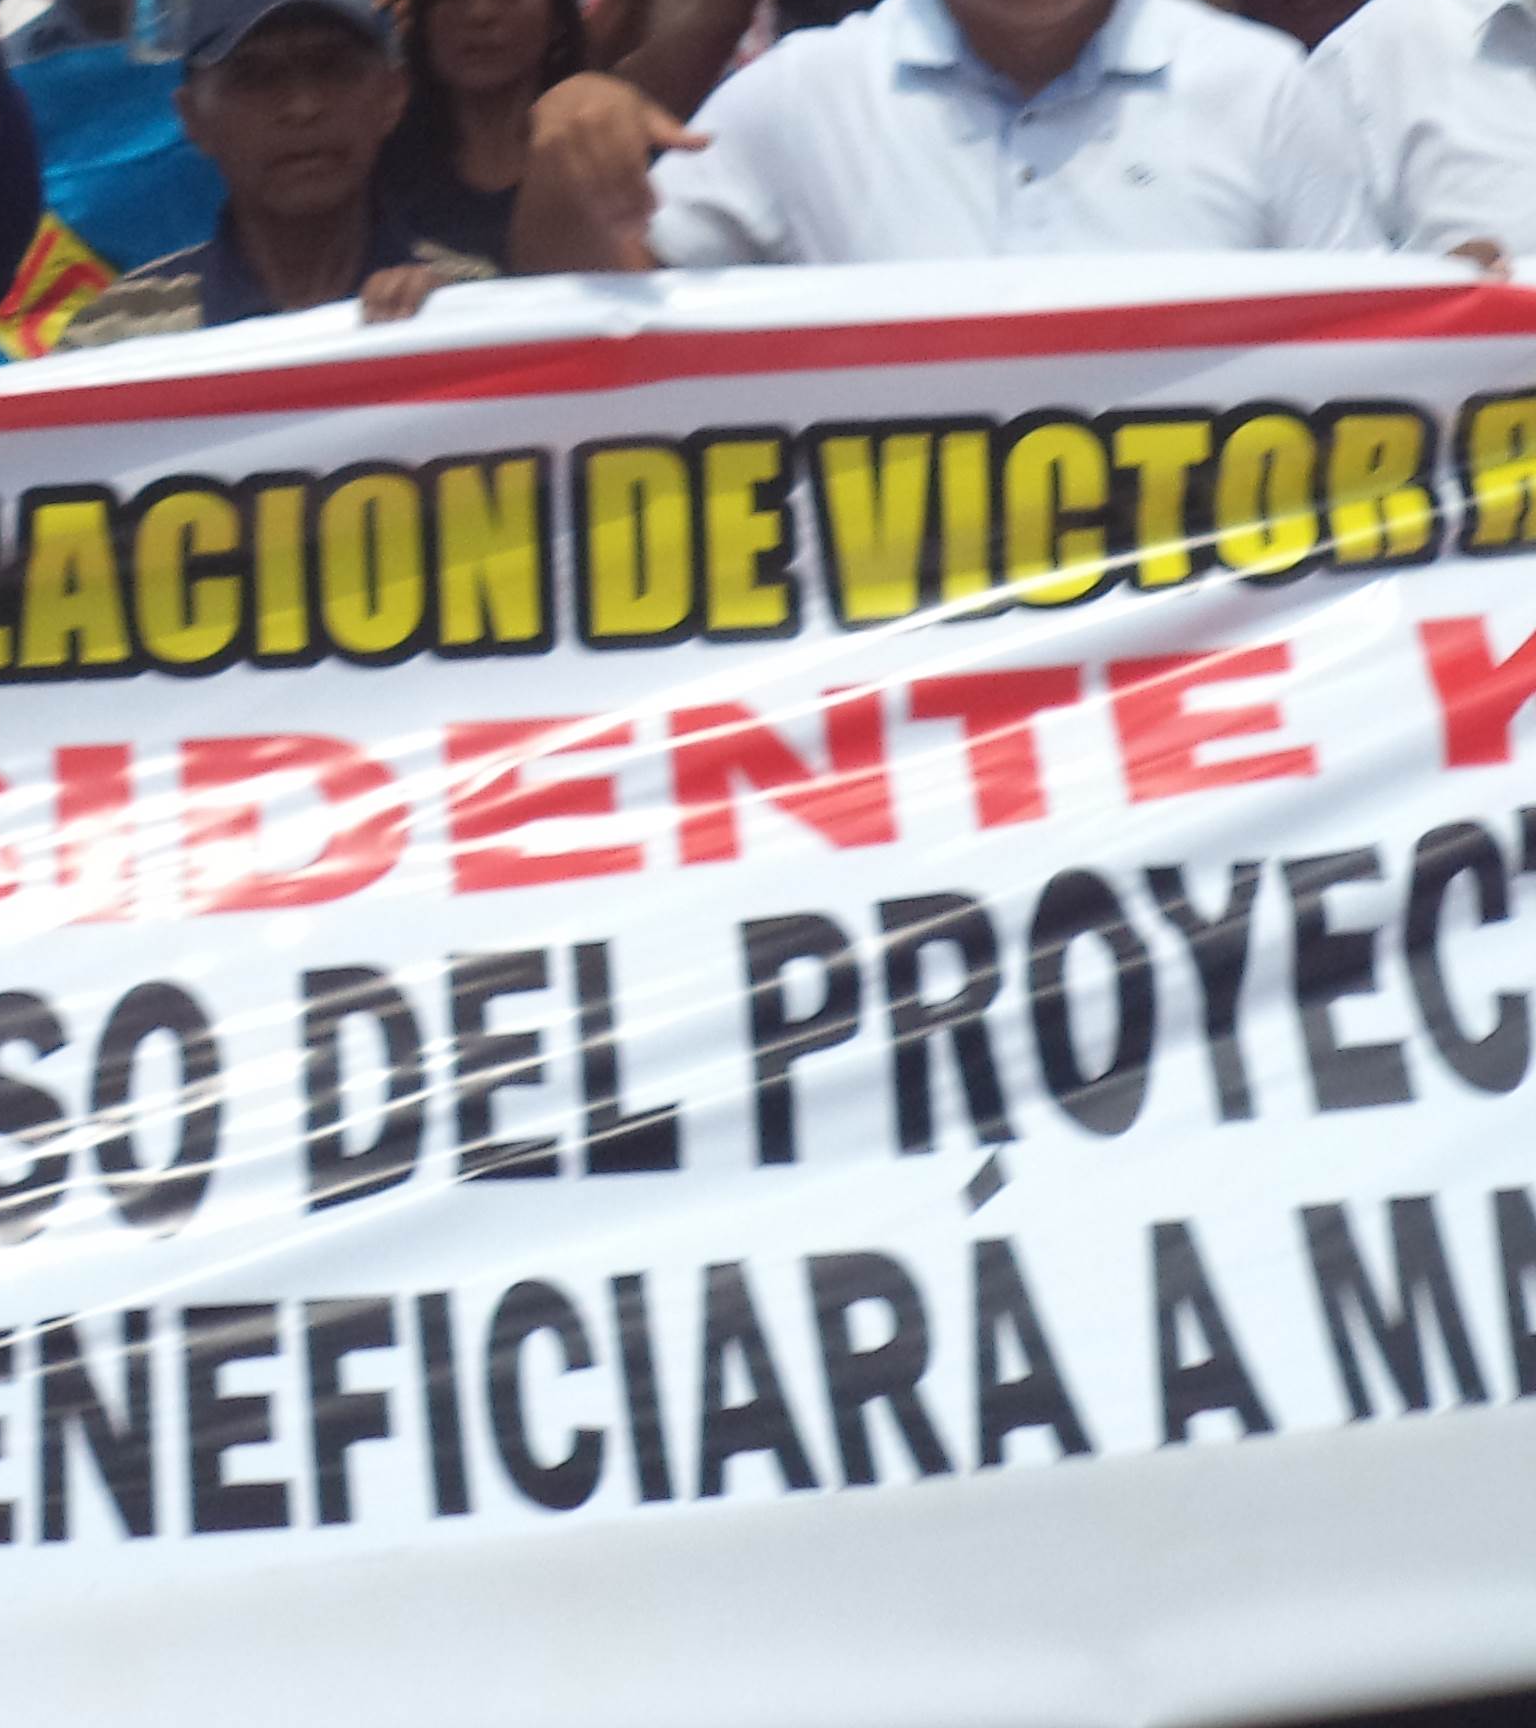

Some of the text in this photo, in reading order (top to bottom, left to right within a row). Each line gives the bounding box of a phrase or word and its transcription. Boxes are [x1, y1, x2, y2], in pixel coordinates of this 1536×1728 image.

[571, 422, 801, 649] DE
[801, 399, 1445, 631] VICTOR
[300, 940, 684, 1214] DEL
[1148, 1219, 1277, 1450] A
